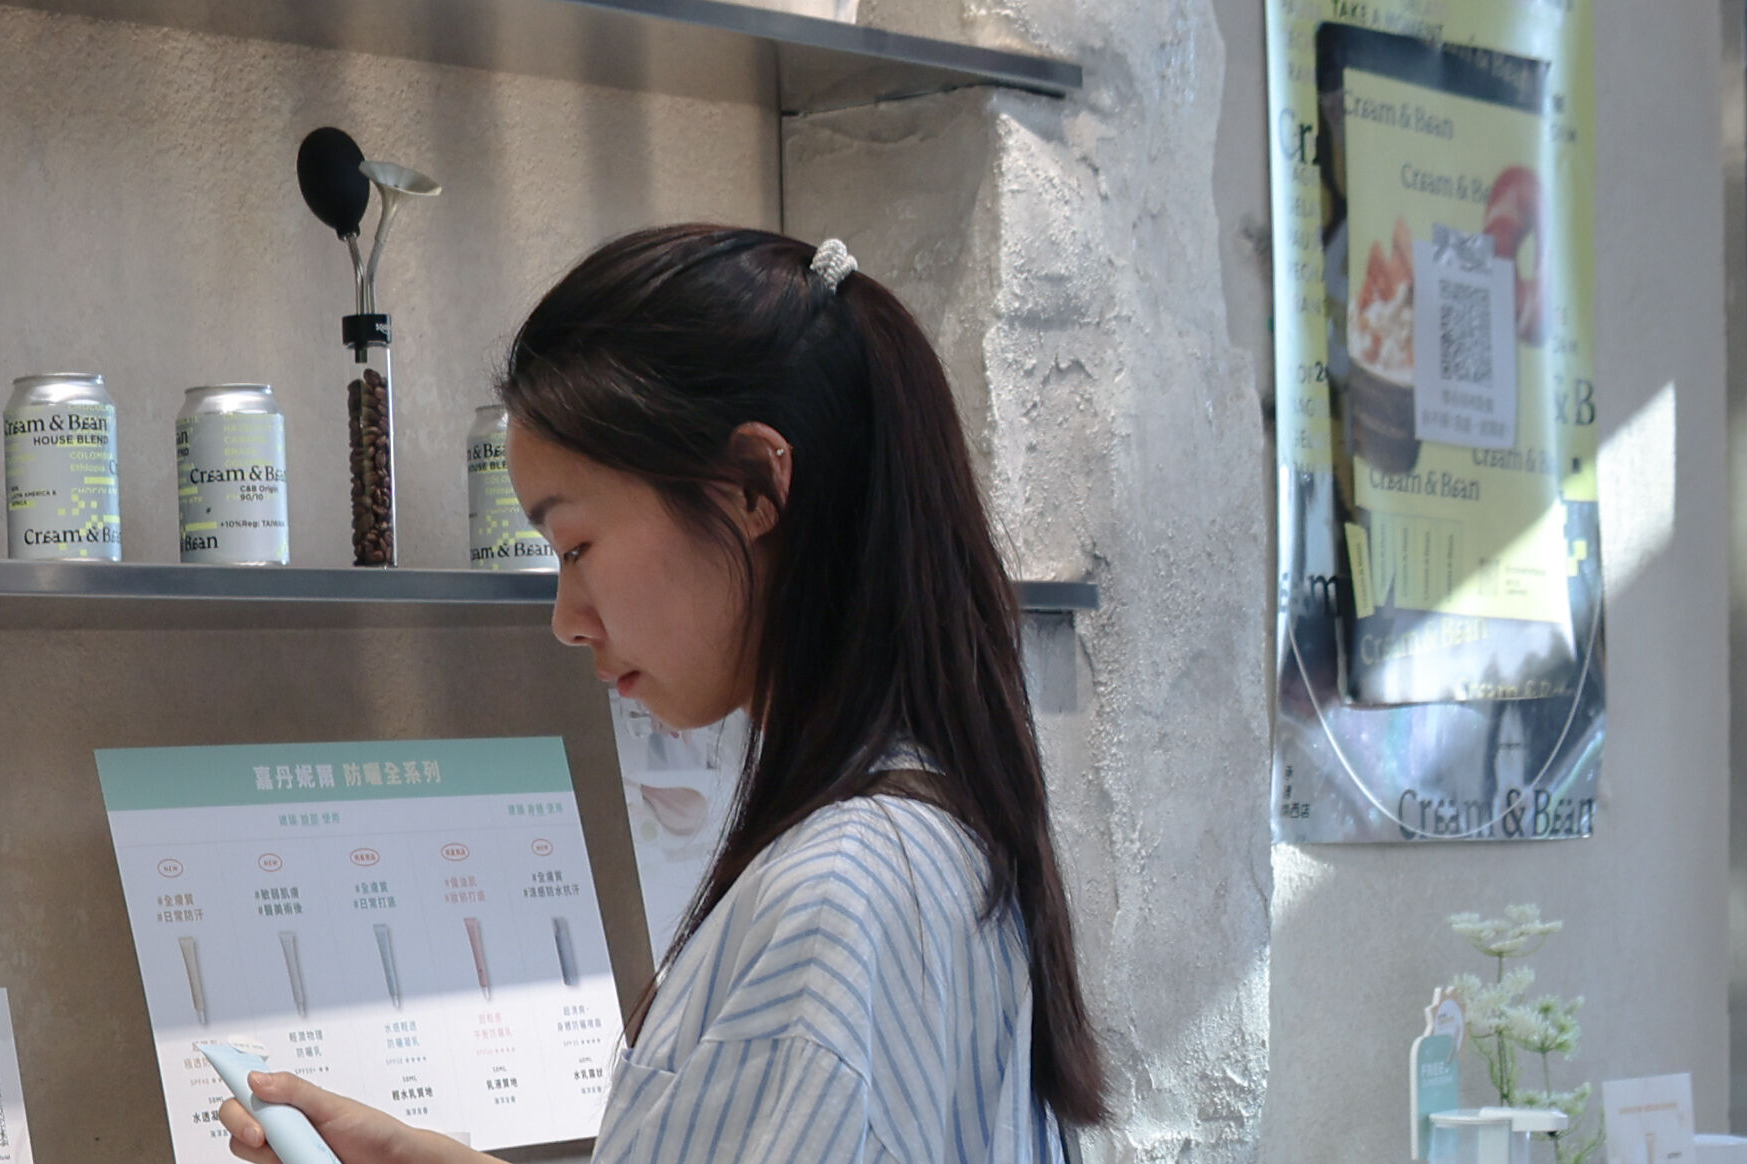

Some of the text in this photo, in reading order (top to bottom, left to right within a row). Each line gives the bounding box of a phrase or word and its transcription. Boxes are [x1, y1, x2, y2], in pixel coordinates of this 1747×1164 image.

[49, 413, 64, 431] &
[68, 413, 108, 431] Bean
[33, 434, 109, 446] HOUSE BLEND
[190, 465, 262, 484] Cream &
[24, 526, 99, 545] Cream &
[497, 542, 510, 558] &
[253, 760, 441, 790] 嘉丹妮爾 防曬全系列
[1398, 788, 1594, 840] Cream & Bean
